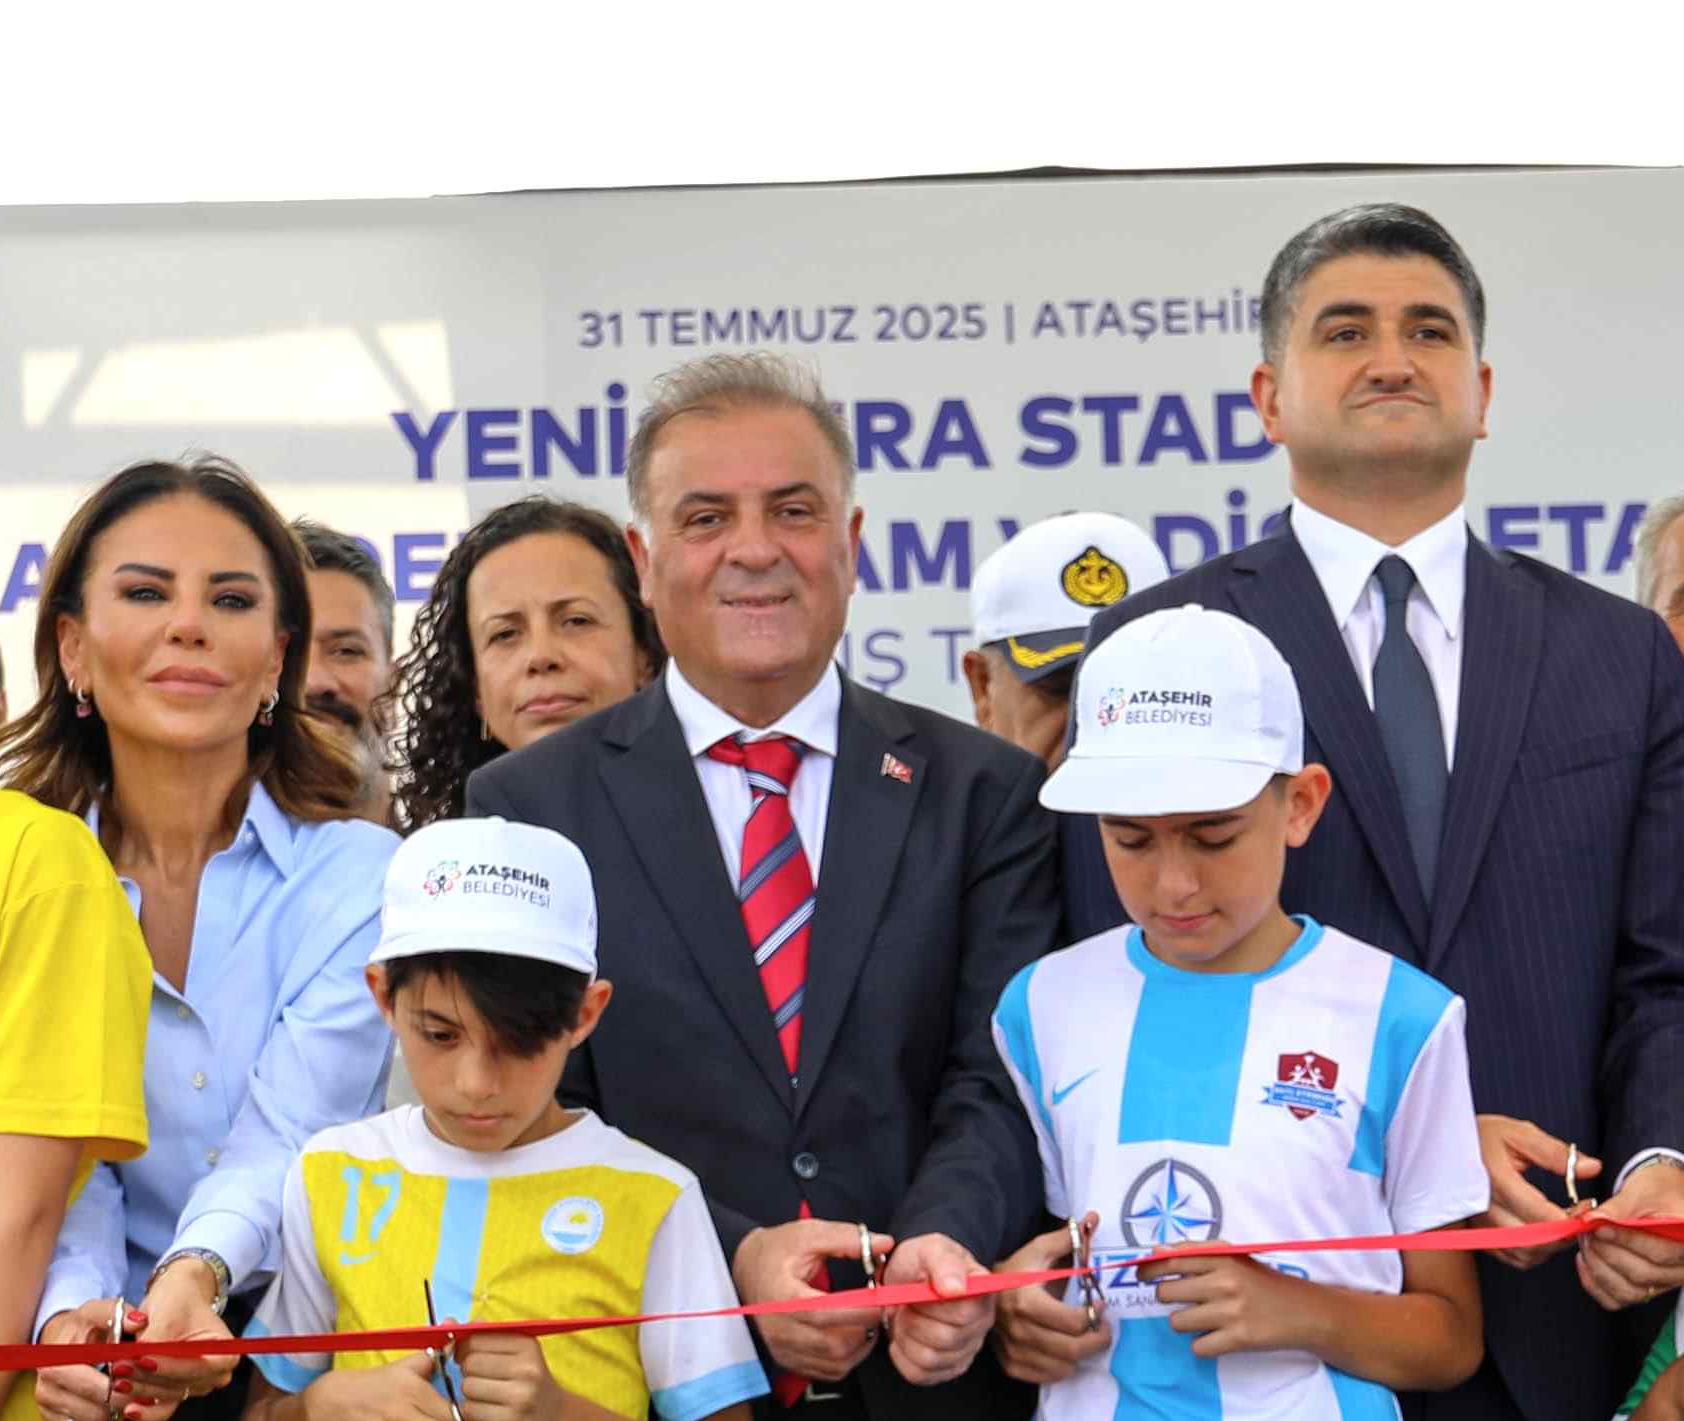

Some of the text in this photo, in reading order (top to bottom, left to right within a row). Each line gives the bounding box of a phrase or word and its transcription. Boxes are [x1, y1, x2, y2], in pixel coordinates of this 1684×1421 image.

[580, 311, 624, 348] 31
[641, 307, 857, 346] TEMMUZ
[875, 305, 986, 341] 2025
[1129, 690, 1213, 708] ATAŞEHİR
[1126, 709, 1213, 728] BELEDİYESİ
[465, 864, 550, 891] ATAŞEHİR
[462, 880, 551, 909] BELEDİYESİ
[340, 1167, 403, 1244] 17
